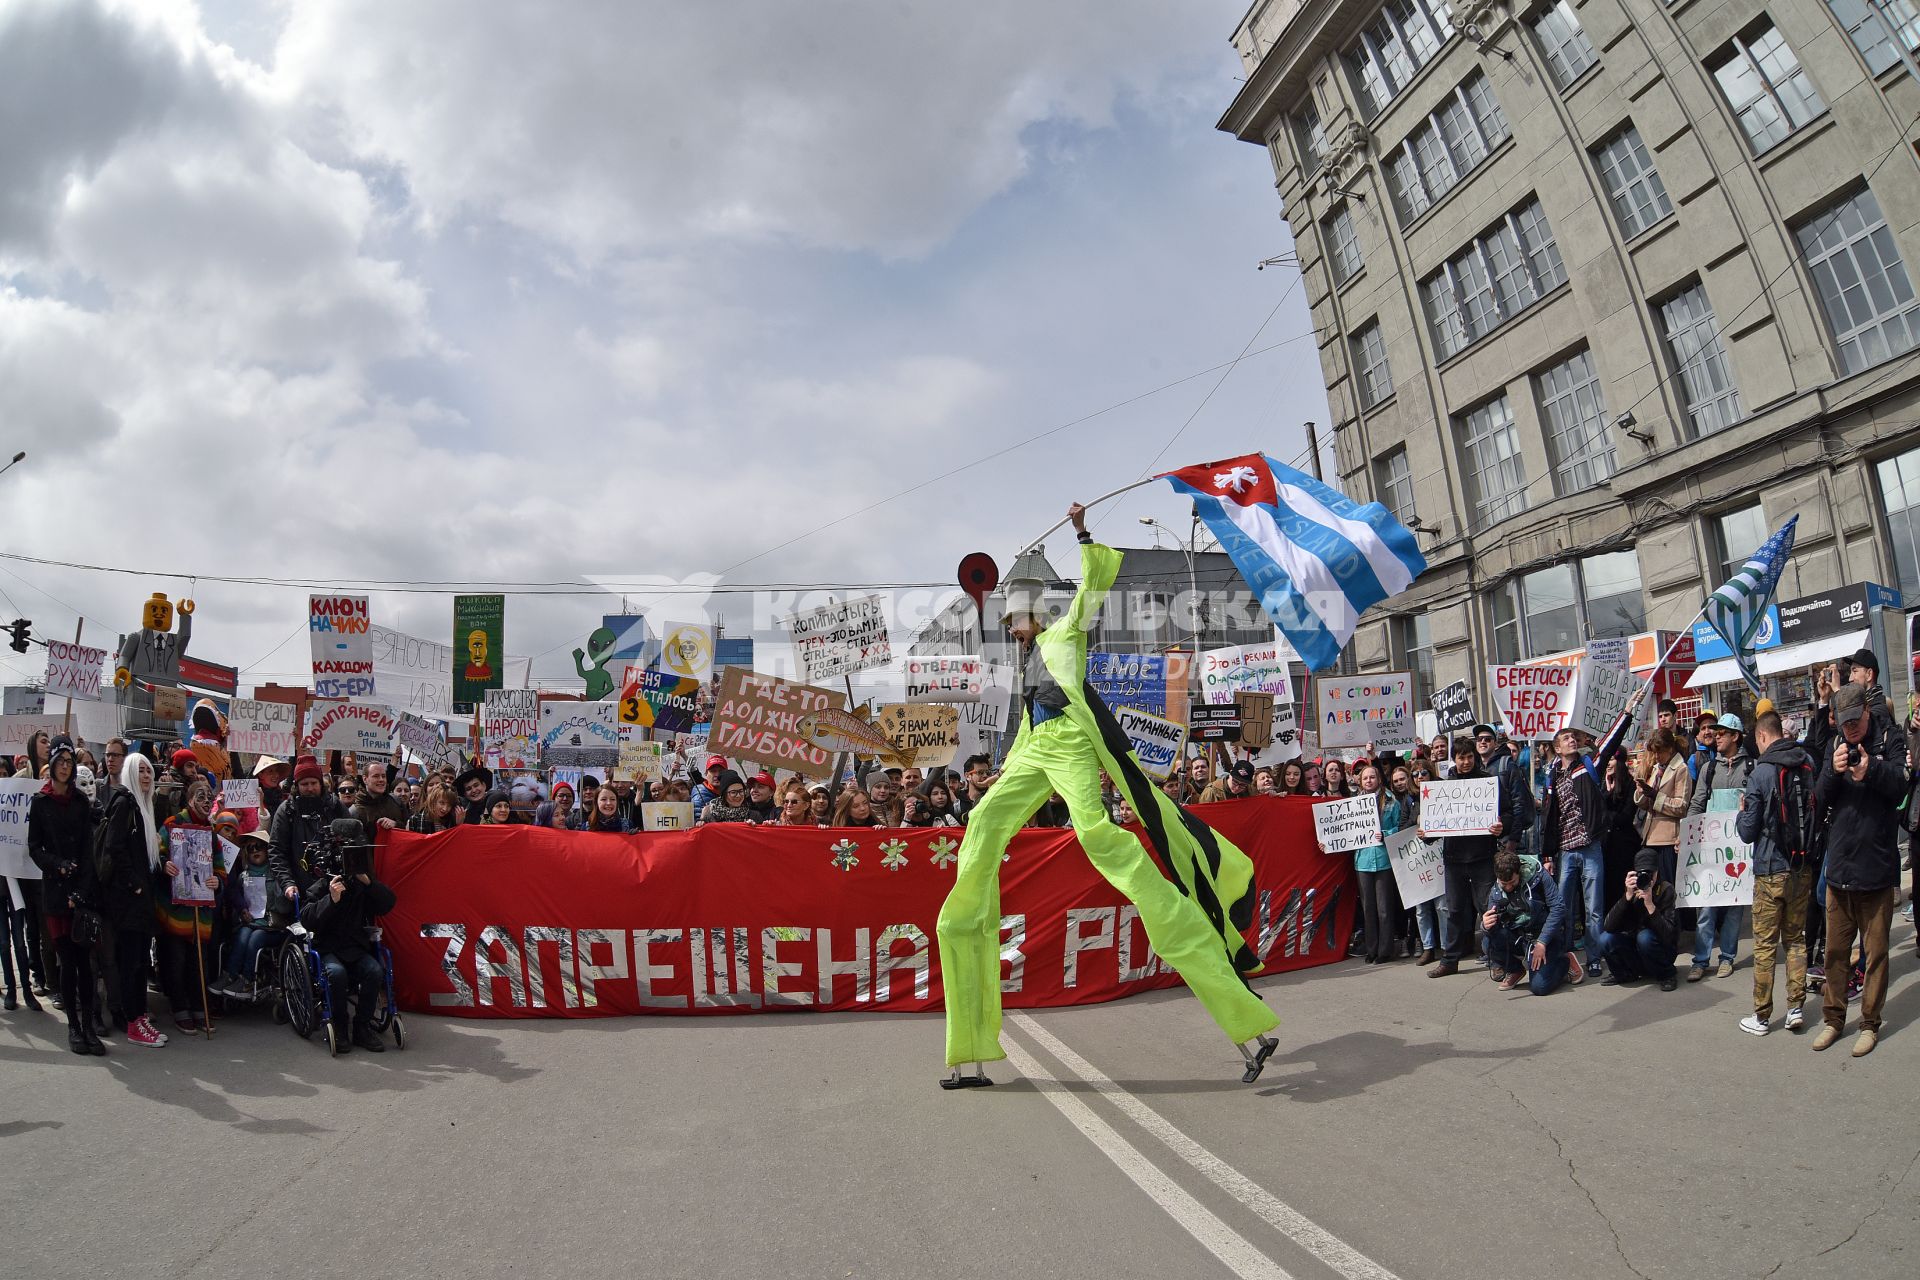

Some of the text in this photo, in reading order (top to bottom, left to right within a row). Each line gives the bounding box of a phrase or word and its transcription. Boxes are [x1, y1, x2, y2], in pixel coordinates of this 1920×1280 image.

[310, 598, 367, 618] КЛЮЧ
[1780, 599, 1833, 617] Подключайтесь
[1839, 600, 1864, 619] TELE2
[848, 617, 872, 638] ВАМ
[872, 615, 887, 631] НЕ
[1782, 618, 1801, 629] здесь
[49, 643, 105, 666] КОСМОС
[1244, 650, 1277, 665] РЕКЛАМА
[312, 659, 374, 675] КАЖДОМУ
[814, 652, 892, 680] СОВЕРШИТЬ НАДО
[909, 660, 981, 675] ОТВЕДАЙ
[47, 663, 100, 695] РУХНУЛ
[626, 668, 662, 688] МЕНЯ
[907, 676, 980, 697] ПЛАЦЕБО
[1496, 668, 1573, 689] БЕРЕГИСЬ!
[1592, 665, 1620, 690] ГОРИ
[1621, 676, 1629, 694] В
[485, 689, 538, 709] ИСКУССТВО
[635, 688, 696, 711] ОСТАЛОСЬ
[738, 673, 829, 712] ГДЕ-ТО
[1211, 690, 1233, 706] НАС
[1346, 680, 1406, 699] СТОИШЬ?
[1509, 689, 1559, 710] НЕБО
[623, 697, 639, 721] 3
[1327, 699, 1409, 726] ЛЕВИТИРУЙ!
[357, 730, 378, 738] ВАШ
[485, 719, 538, 738] НАРОДУ
[907, 719, 930, 732] ВАМ
[1120, 713, 1183, 742] ГУМАННЫЕ
[1376, 721, 1403, 729] GREEN
[230, 729, 293, 754] IMPROV
[362, 738, 392, 750] ПРЯНЯ
[717, 721, 828, 766] ГЛУБОКО
[1129, 736, 1177, 767] ТРОЕНИЯ
[226, 779, 251, 791] МИРУ
[1435, 781, 1497, 801] ДОЛОЙ
[0, 793, 34, 807] СЛУГИ
[1327, 799, 1376, 815] ТУТ ЧТО
[1427, 802, 1493, 815] ПЛАТНЫЕ
[1319, 807, 1375, 825] СОГЛАСОВАННАЯ
[1323, 818, 1377, 836] МОНСТРАЦИЯ
[1327, 830, 1375, 851] ЧТО-ЛИ?
[1418, 870, 1434, 885] НЕ
[420, 923, 929, 1010] ЗАПРЕЩЕНА
[1063, 884, 1344, 989] РОИИ
